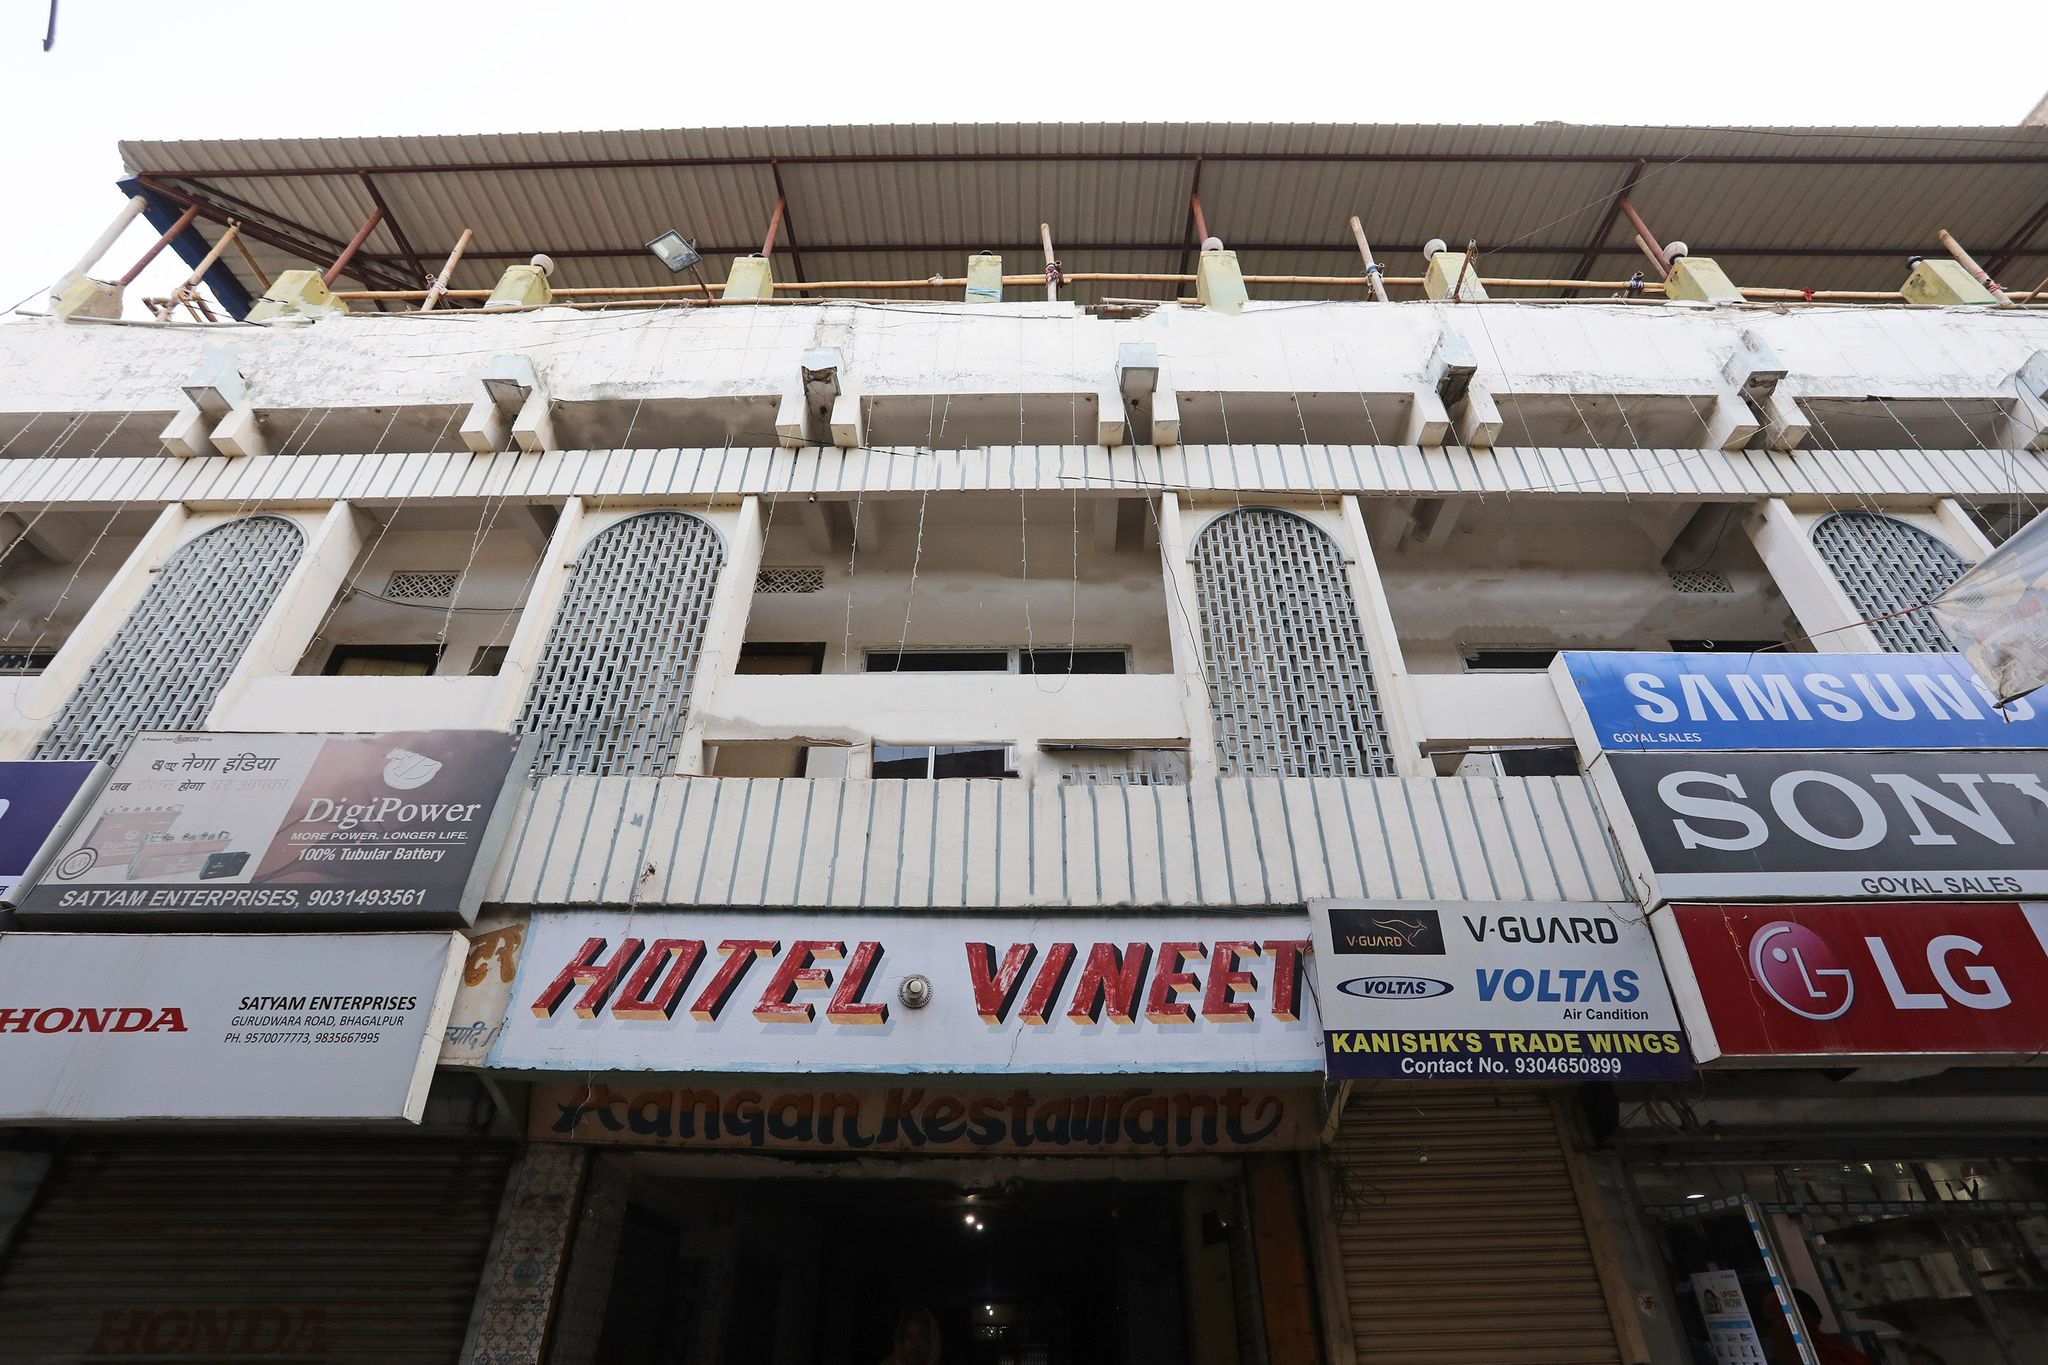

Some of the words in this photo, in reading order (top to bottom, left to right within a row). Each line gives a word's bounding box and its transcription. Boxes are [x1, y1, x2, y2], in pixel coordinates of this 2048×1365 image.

[1613, 732, 1657, 744] GOYAL
[1659, 732, 1702, 743] SALES
[223, 753, 280, 773] इंडिया
[178, 779, 206, 791] होगा
[300, 797, 481, 830] DigiPower
[291, 832, 327, 840] MORE
[331, 832, 379, 840] POWER.
[383, 832, 436, 840] LONGER
[439, 832, 468, 840] LIFE.
[298, 849, 335, 861] 100%
[340, 848, 391, 861] Tubular
[394, 848, 446, 862] Battery
[1861, 877, 1943, 895] GOYAL
[1948, 876, 2023, 894] SALES
[59, 890, 146, 906] SATYAM
[149, 890, 300, 909] ENTERPRISES,
[307, 889, 426, 905] 9031493561
[1462, 916, 1619, 944] V-GUARD
[1346, 935, 1402, 947] V-GUARD
[1864, 934, 2012, 1010] LG
[531, 937, 890, 1026] HOTEL
[965, 940, 1312, 1025] VINEET
[1364, 980, 1427, 995] VOLTAS
[1476, 968, 1640, 1002] VOLTAS
[238, 996, 306, 1010] SATYAM
[309, 996, 416, 1010] ENTERPRISES
[0, 1007, 188, 1034] HONDA
[231, 1016, 301, 1026] GURUDWARA
[304, 1016, 335, 1027] ROAD,
[340, 1016, 404, 1026] BHAGALPUR
[1563, 1008, 1582, 1020] Air
[1585, 1008, 1649, 1020] Candition
[224, 1033, 241, 1043] PH.
[244, 1033, 310, 1044] 9570077773,
[315, 1032, 379, 1043] 9835667995
[1331, 1032, 1482, 1053] KANISHK'S
[1490, 1033, 1581, 1053] TRADE
[1587, 1033, 1681, 1054] WINGS
[1401, 1057, 1472, 1074] Contact
[1478, 1057, 1509, 1073] No.
[1515, 1056, 1622, 1074] 9304650899
